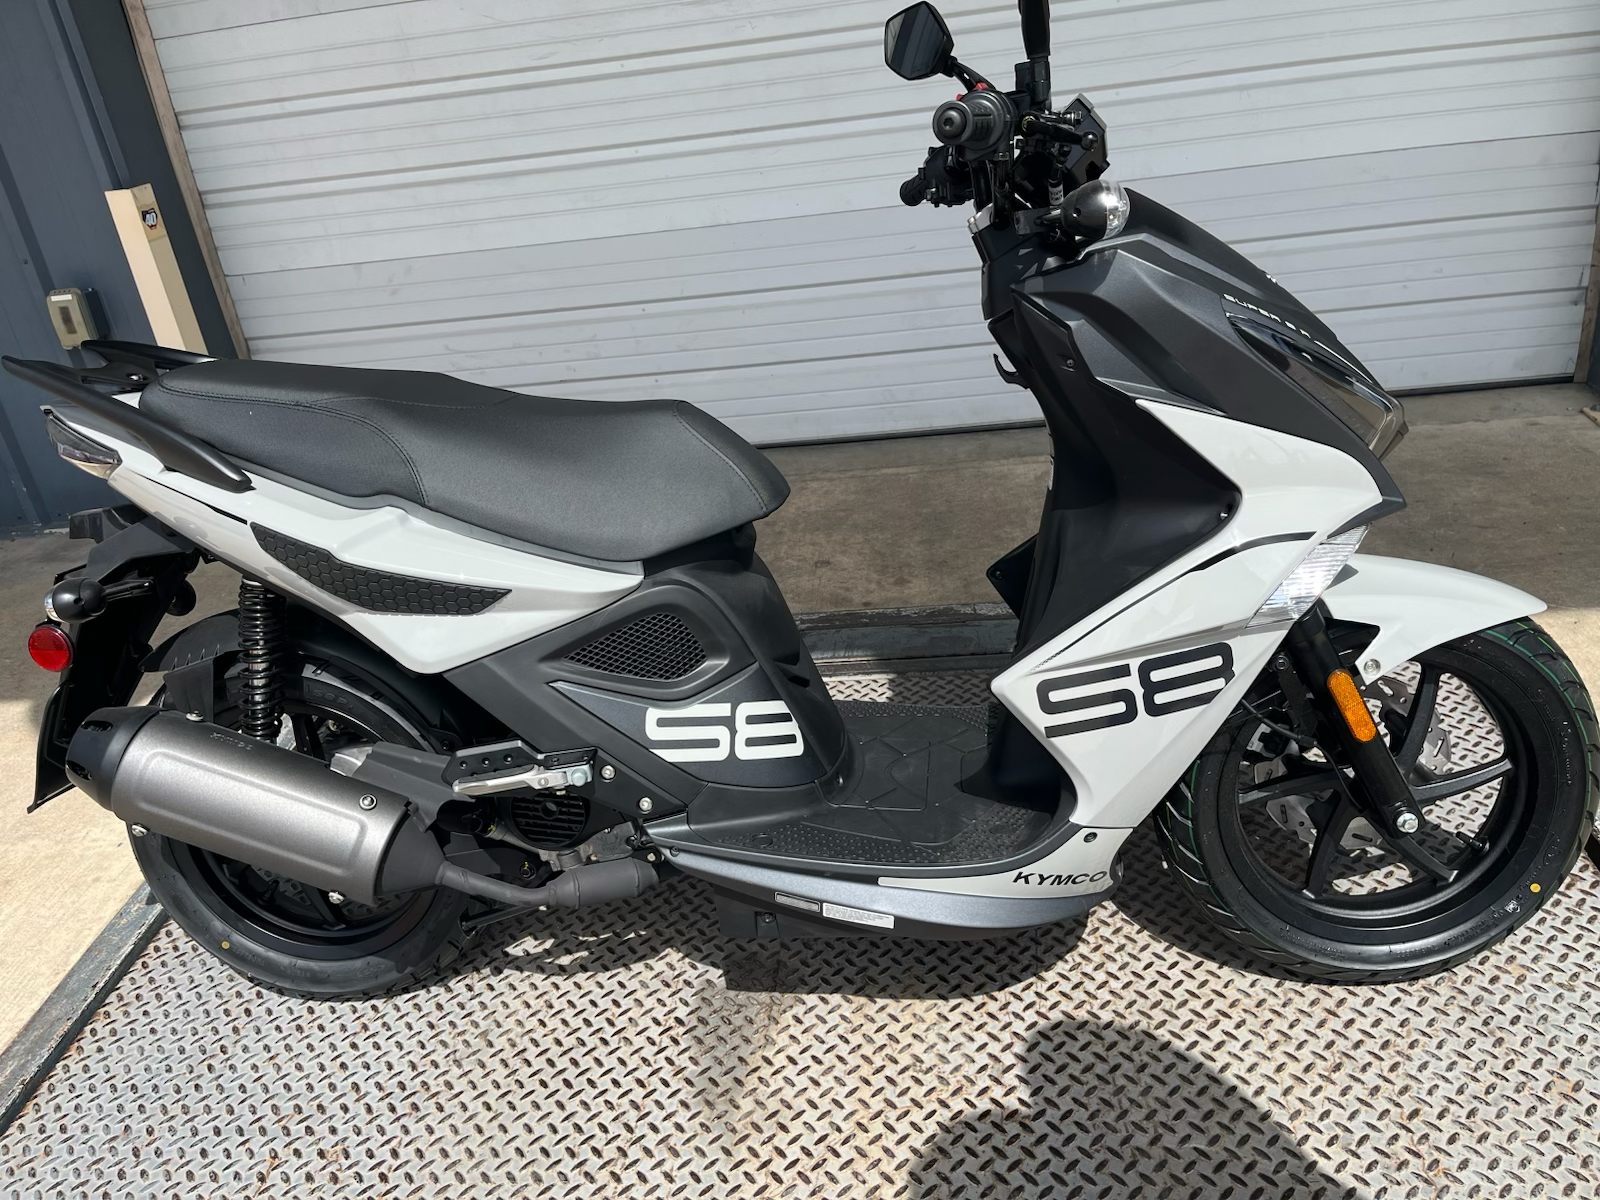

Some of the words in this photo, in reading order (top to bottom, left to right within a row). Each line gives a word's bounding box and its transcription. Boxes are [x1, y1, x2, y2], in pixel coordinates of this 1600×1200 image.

[1223, 293, 1281, 322] SUPER
[1036, 641, 1235, 738] S8
[645, 700, 805, 763] S8
[1012, 870, 1108, 886] KYMCO
